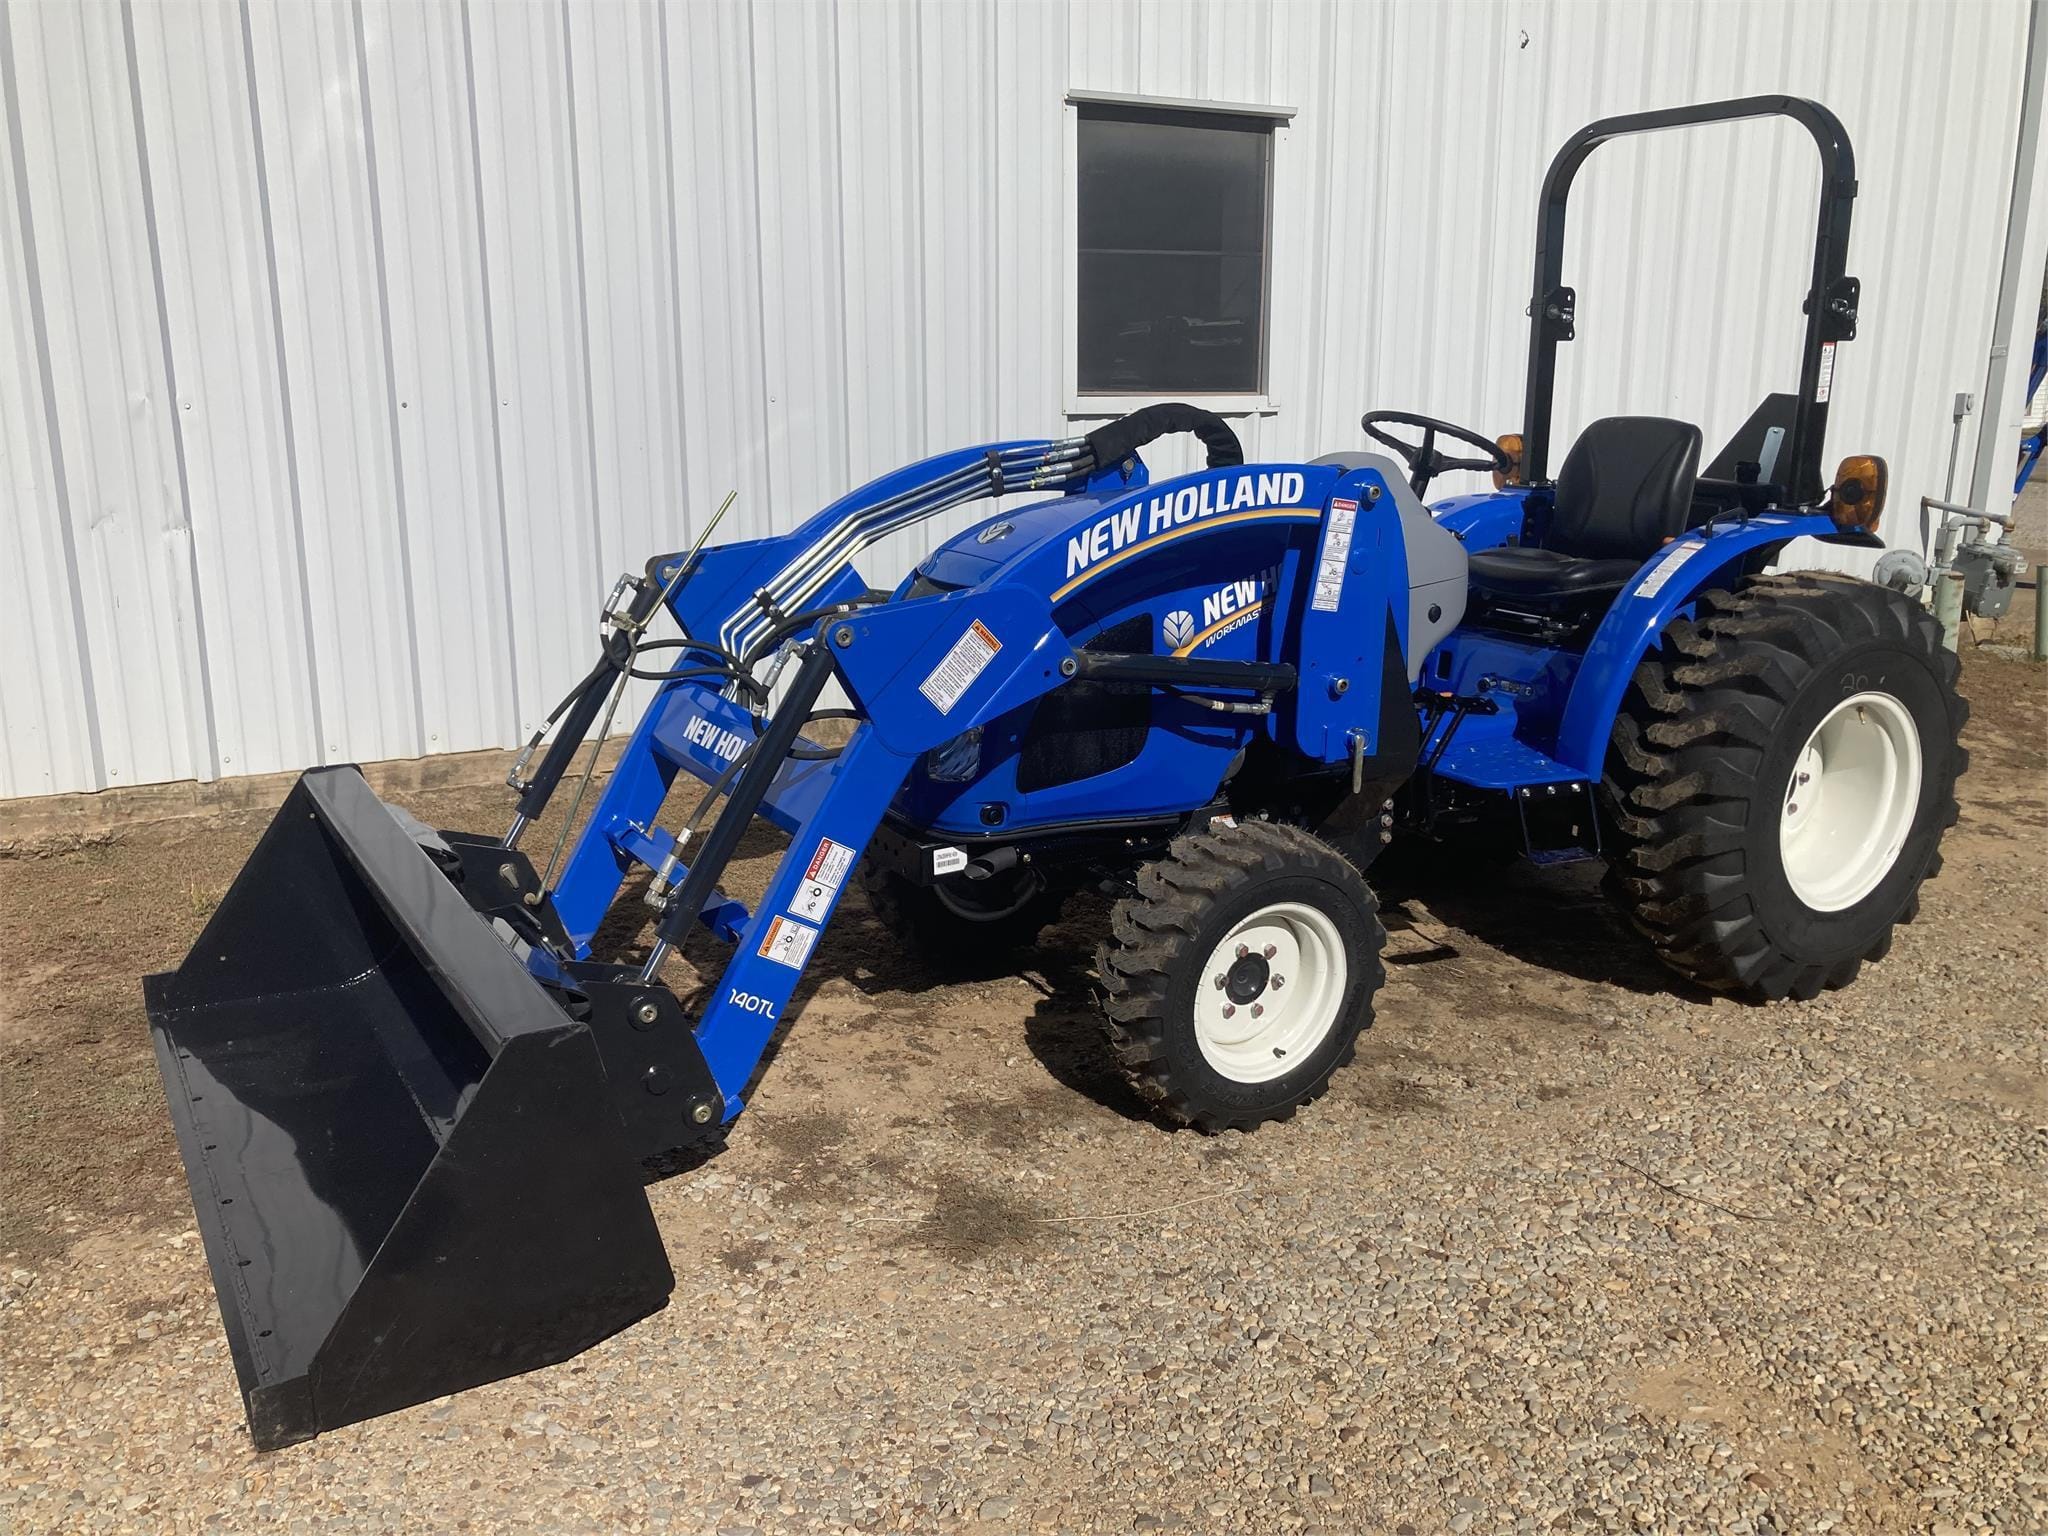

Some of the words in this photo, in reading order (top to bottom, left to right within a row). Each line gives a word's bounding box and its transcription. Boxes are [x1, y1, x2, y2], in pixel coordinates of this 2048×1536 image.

[1067, 502, 1143, 579] NEW
[1148, 472, 1305, 535] HOLLAND
[1203, 575, 1256, 627] NEW
[682, 715, 721, 750] NEW
[814, 842, 830, 870] DANGER
[728, 988, 776, 1020] 140TL
